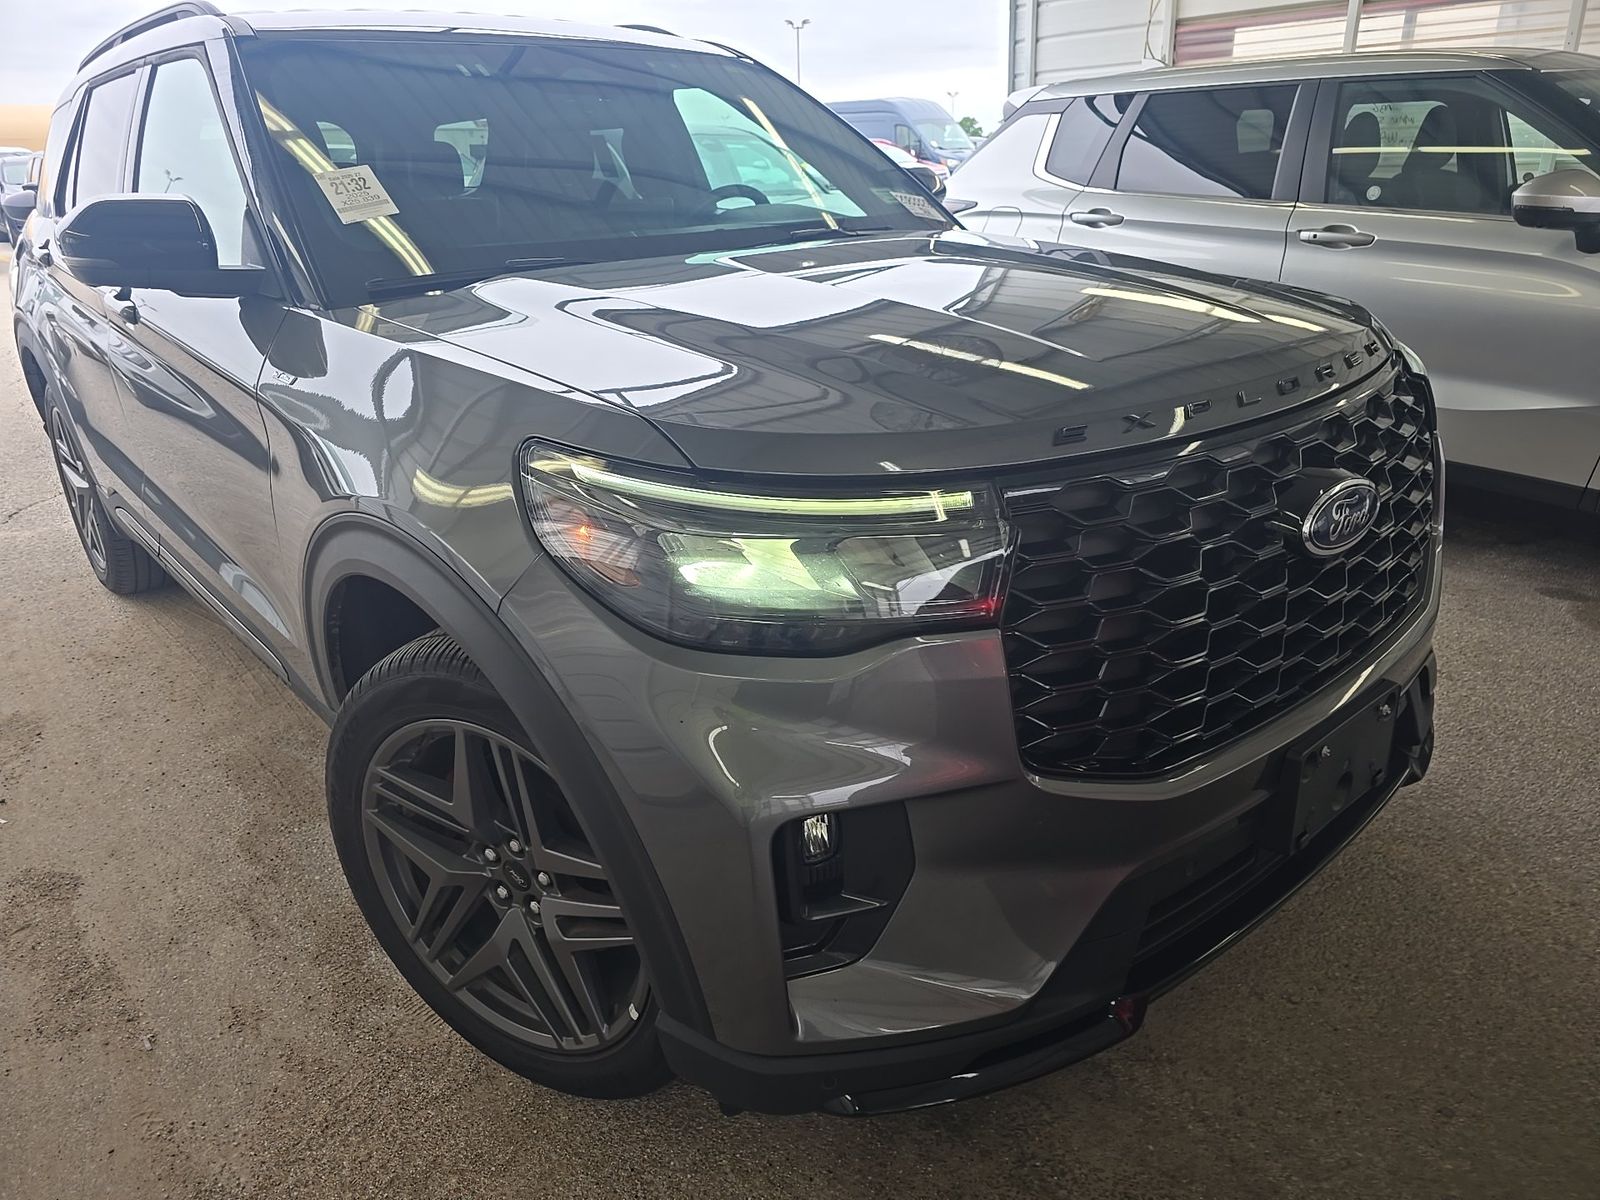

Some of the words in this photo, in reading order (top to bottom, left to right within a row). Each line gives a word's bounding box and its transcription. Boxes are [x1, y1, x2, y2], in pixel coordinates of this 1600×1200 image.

[330, 177, 371, 195] 21:32
[1053, 340, 1381, 445] EXPLORER
[1329, 493, 1370, 541] Ford
